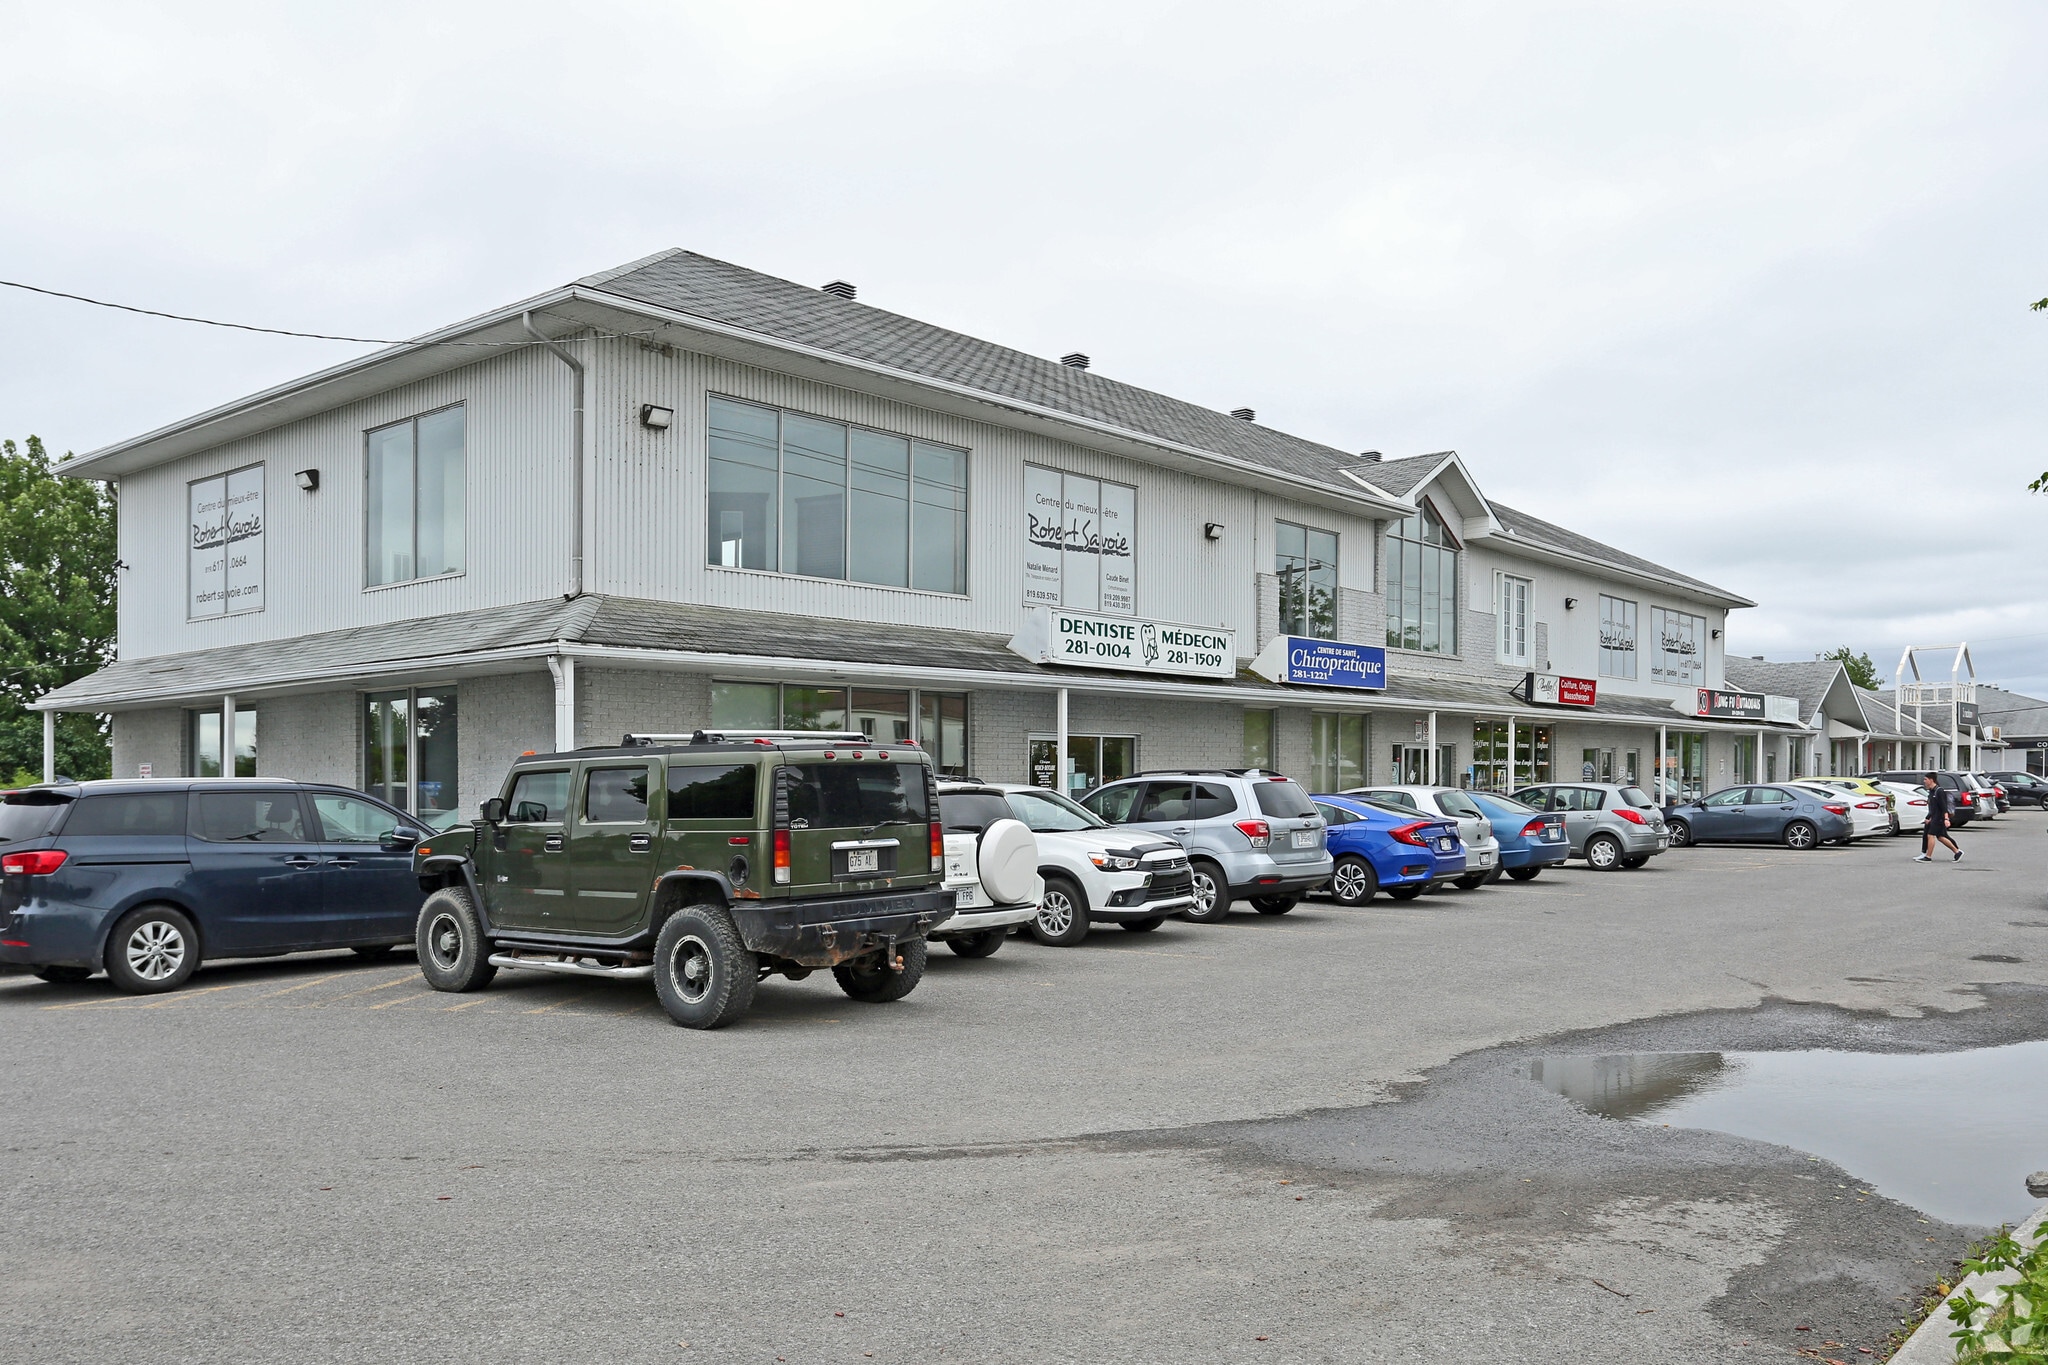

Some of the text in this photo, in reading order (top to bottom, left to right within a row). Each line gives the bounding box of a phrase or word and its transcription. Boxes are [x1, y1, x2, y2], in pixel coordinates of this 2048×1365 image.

[197, 502, 216, 513] Centre
[1036, 493, 1060, 507] Centre
[1065, 499, 1074, 509] du
[193, 511, 260, 545] Robert Savoie
[1028, 513, 1128, 550] Robert Savoie
[1060, 618, 1135, 640] DENTISTE
[1065, 639, 1131, 658] 281-0104
[1161, 629, 1227, 650] MÉDECIN
[1167, 650, 1222, 667] 281-1509
[1317, 646, 1357, 658] CENTRE DE SANTÉ
[1291, 648, 1381, 679] Chiropratique
[1292, 669, 1328, 680] 281-1221
